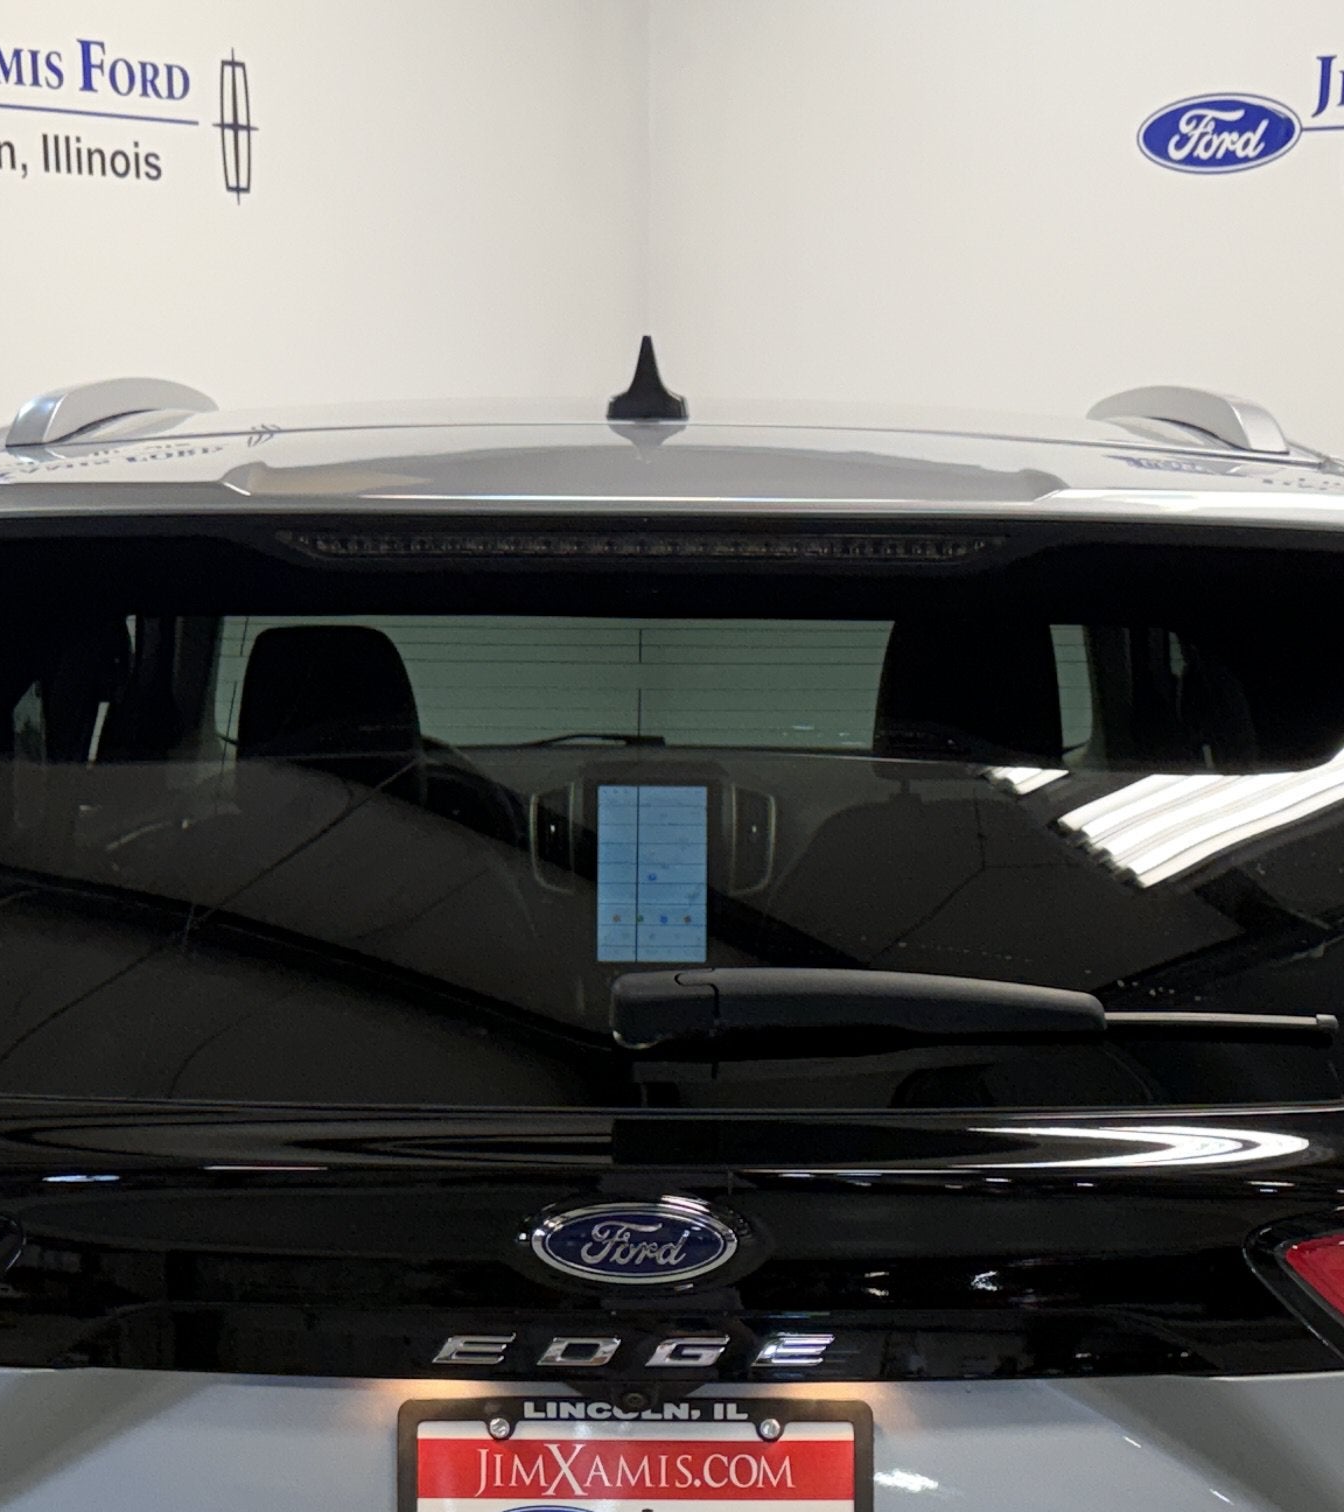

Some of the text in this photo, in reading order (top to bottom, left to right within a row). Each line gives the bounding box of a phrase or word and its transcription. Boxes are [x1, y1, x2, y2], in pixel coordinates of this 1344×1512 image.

[76, 39, 191, 101] FORD
[42, 133, 163, 181] Illinois
[1167, 107, 1266, 162] Ford
[579, 1219, 692, 1267] Ford
[431, 1331, 836, 1369] EDGE
[713, 1403, 749, 1420] IL
[474, 1443, 795, 1497] JIMXAMIS.COM
